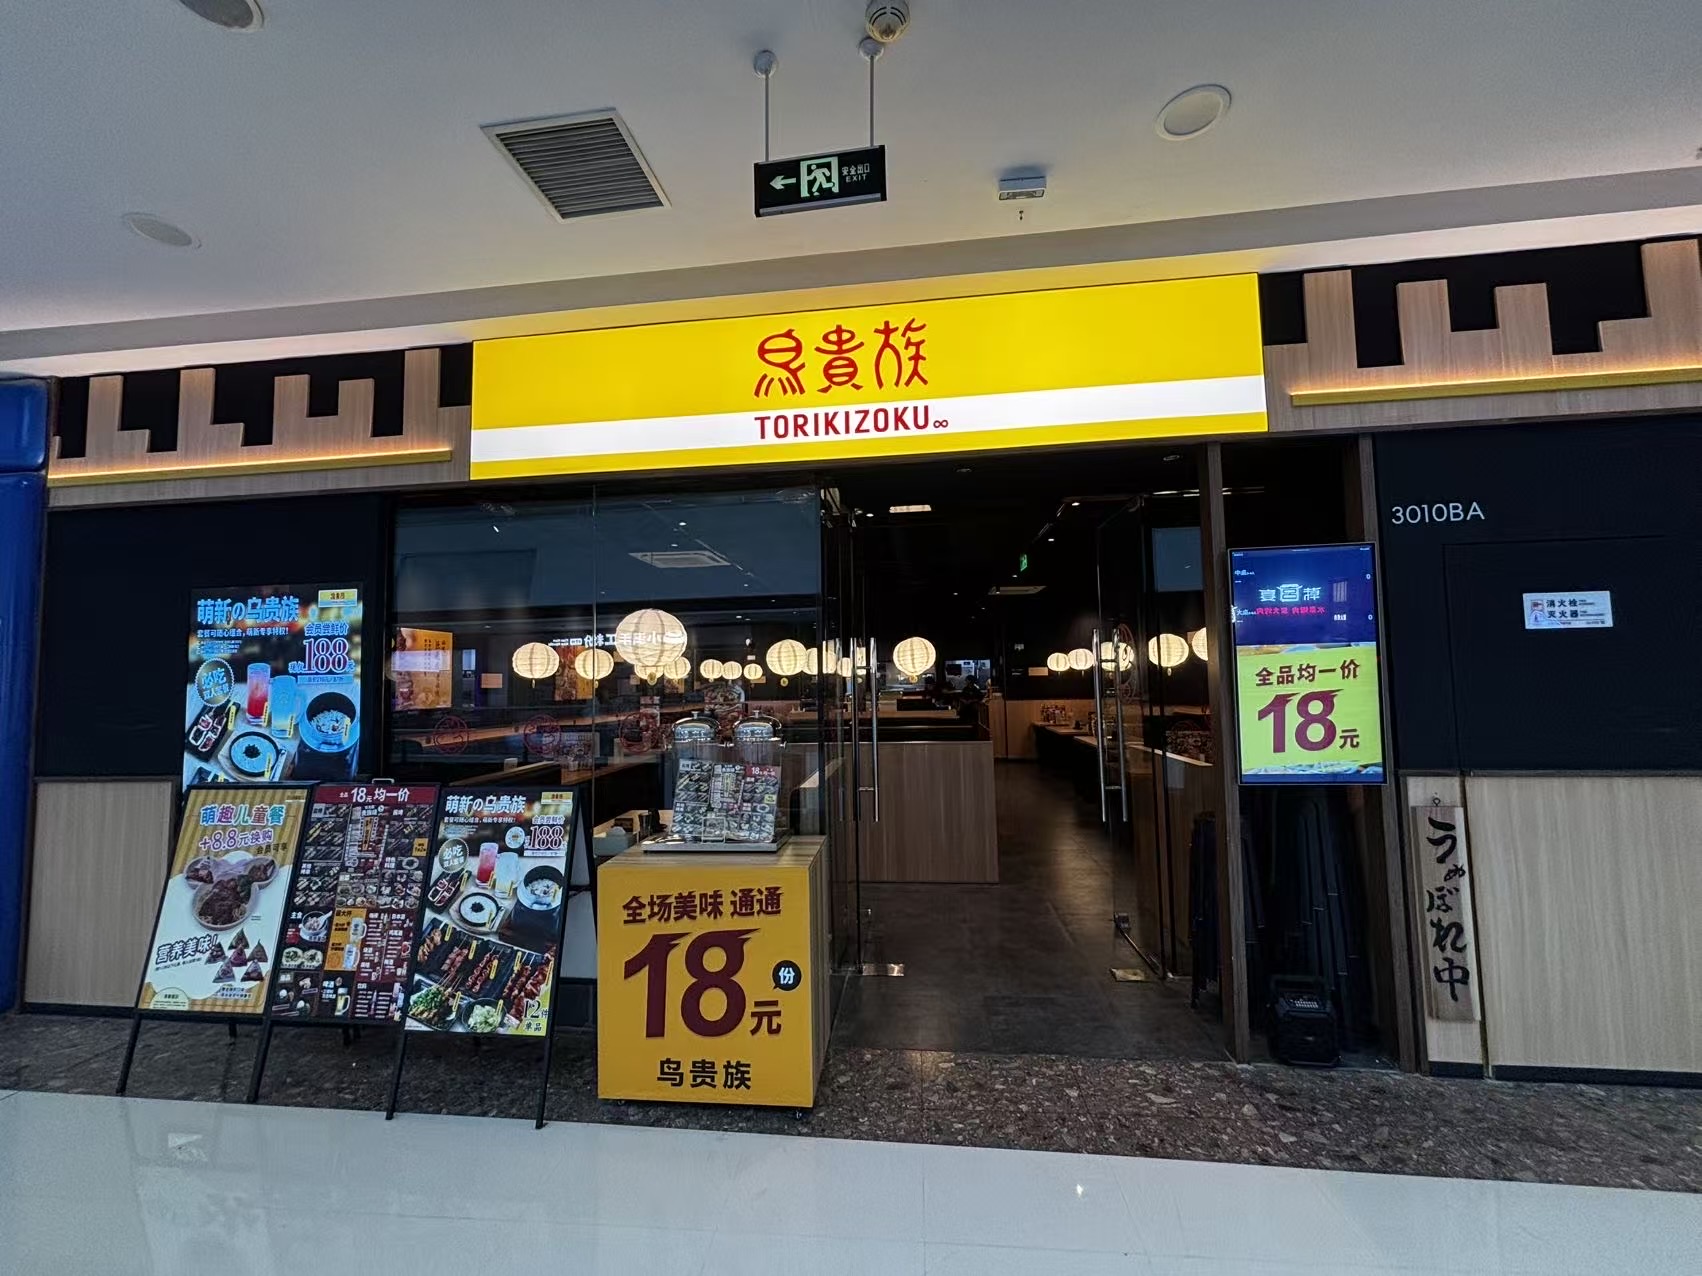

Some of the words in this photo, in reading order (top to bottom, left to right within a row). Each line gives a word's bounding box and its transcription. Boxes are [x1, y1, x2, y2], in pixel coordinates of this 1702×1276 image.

[841, 163, 871, 176] 安全出口
[846, 174, 867, 183] EXIT
[754, 405, 929, 440] TORIKIZOKU
[1391, 501, 1485, 525] 3010BA
[1546, 599, 1578, 608] 消火栓
[1547, 609, 1579, 618] 灭火器
[1255, 659, 1360, 687] 全品均一价
[200, 804, 286, 827] 萌趣儿童餐
[622, 890, 724, 925] 全场美味
[730, 886, 785, 918] 通通
[778, 966, 795, 985] 份
[657, 1058, 752, 1090] 鸟贵族
